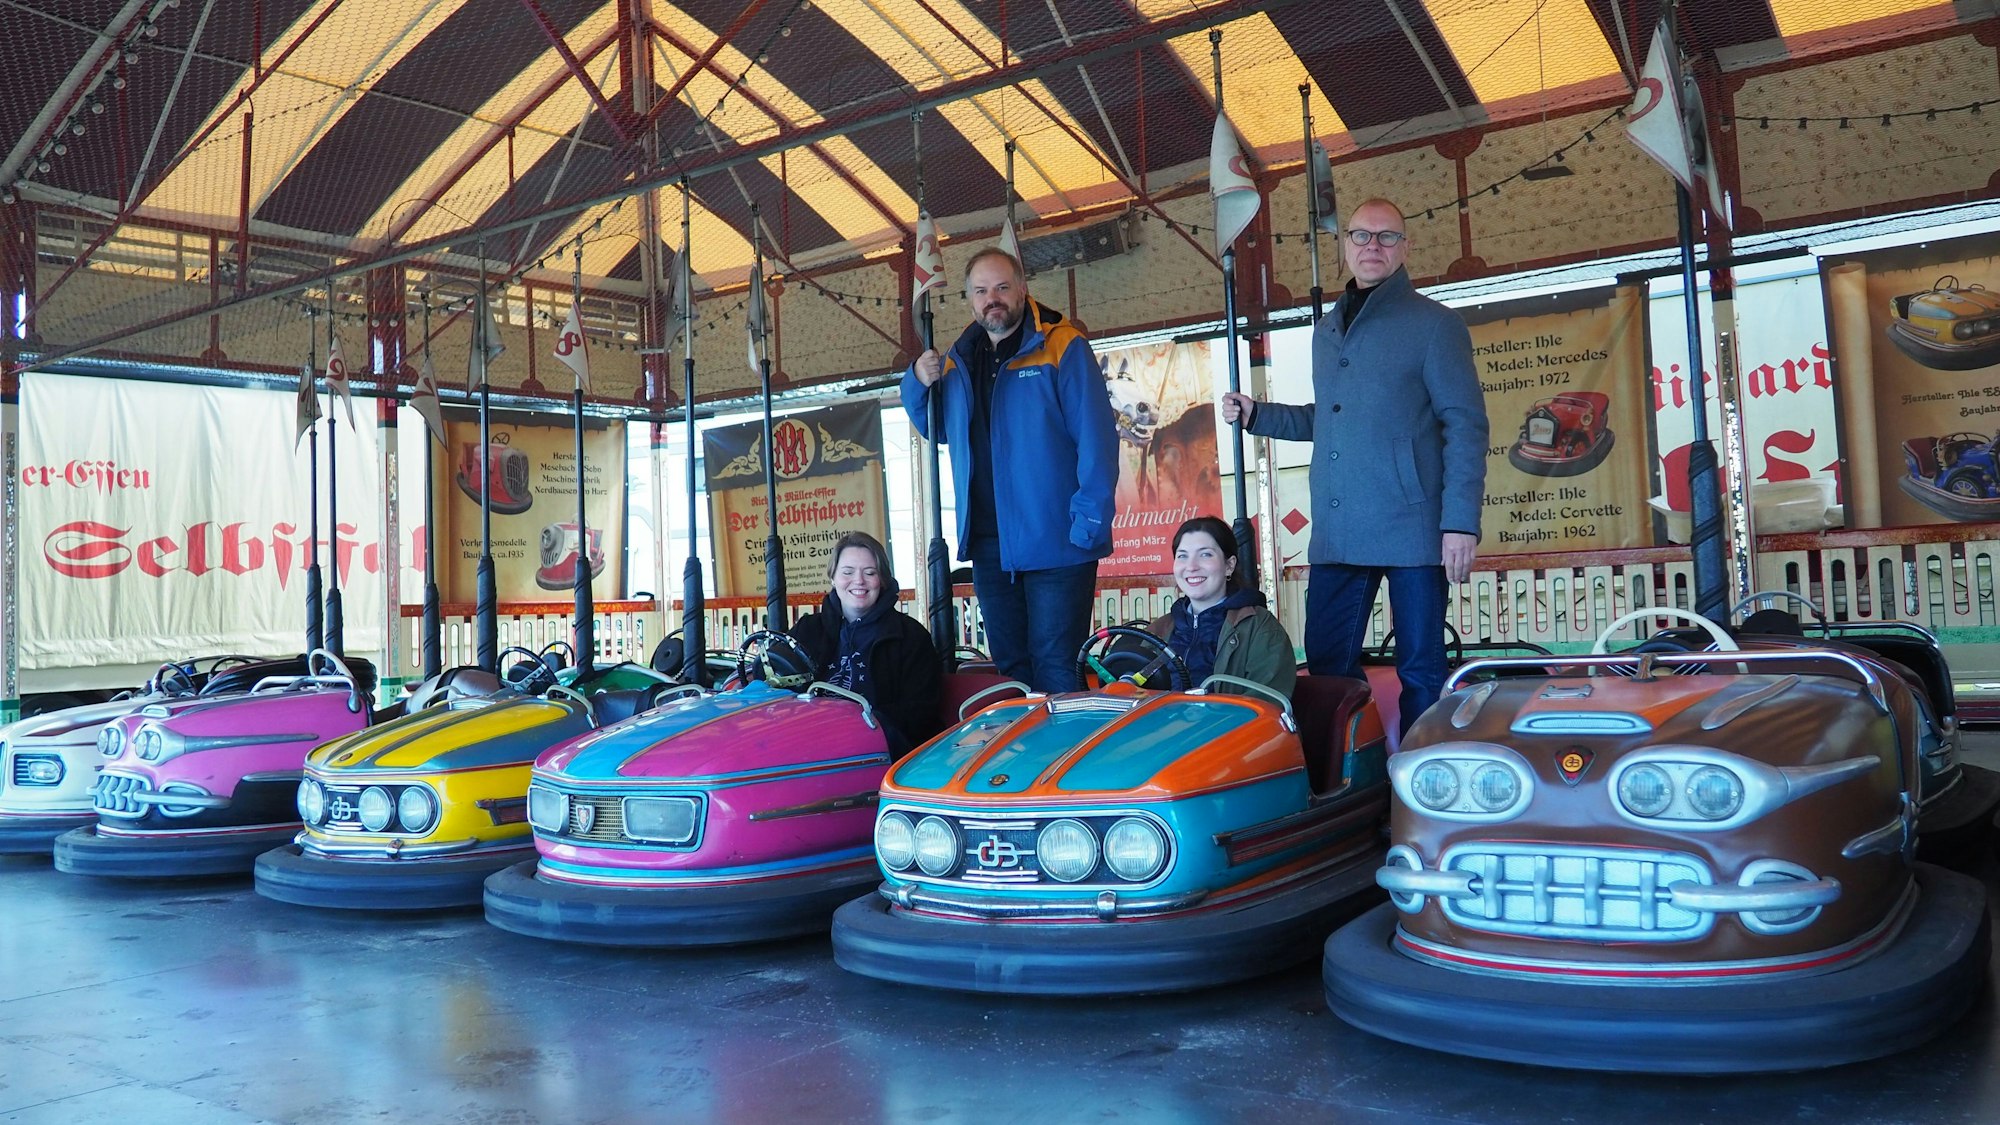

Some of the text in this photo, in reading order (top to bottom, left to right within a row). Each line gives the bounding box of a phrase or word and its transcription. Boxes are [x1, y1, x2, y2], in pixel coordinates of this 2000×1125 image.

[1472, 334, 1563, 357] ersteller: Ihle
[1486, 349, 1608, 374] Model: Mercedes
[1540, 371, 1570, 386] 1972
[1901, 393, 1955, 405] Hersteller:
[1559, 487, 1587, 501] Ihle
[729, 511, 758, 532] Der
[1112, 499, 1198, 528] ahrmarkt
[1509, 504, 1623, 523] Model: Corvette
[1113, 536, 1166, 548] nfang März
[1499, 524, 1596, 544] Baujahr: 1962
[1117, 556, 1130, 564] und
[1132, 554, 1161, 563] Sonntag
